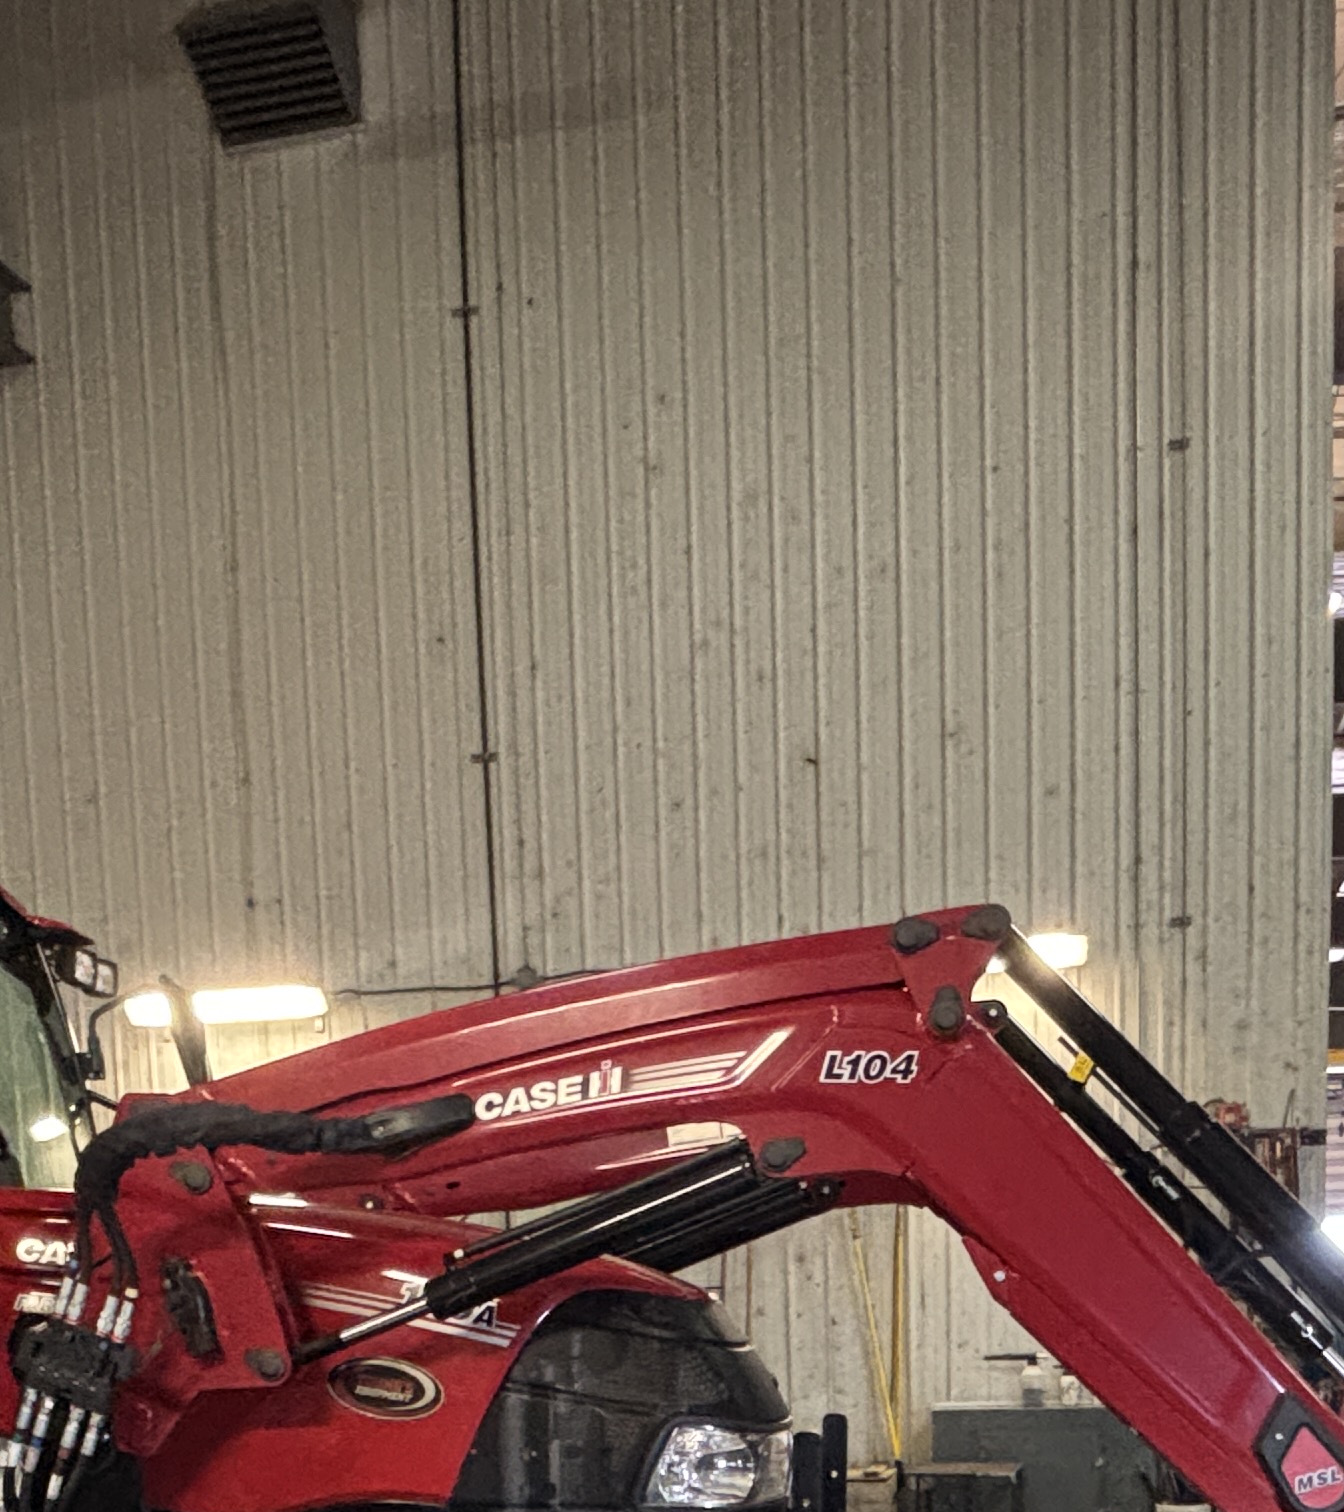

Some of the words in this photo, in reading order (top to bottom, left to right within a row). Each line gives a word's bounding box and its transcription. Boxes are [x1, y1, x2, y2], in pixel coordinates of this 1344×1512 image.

[819, 1050, 920, 1084] L104
[474, 1075, 584, 1121] CASE
[1294, 1465, 1344, 1495] MSL
